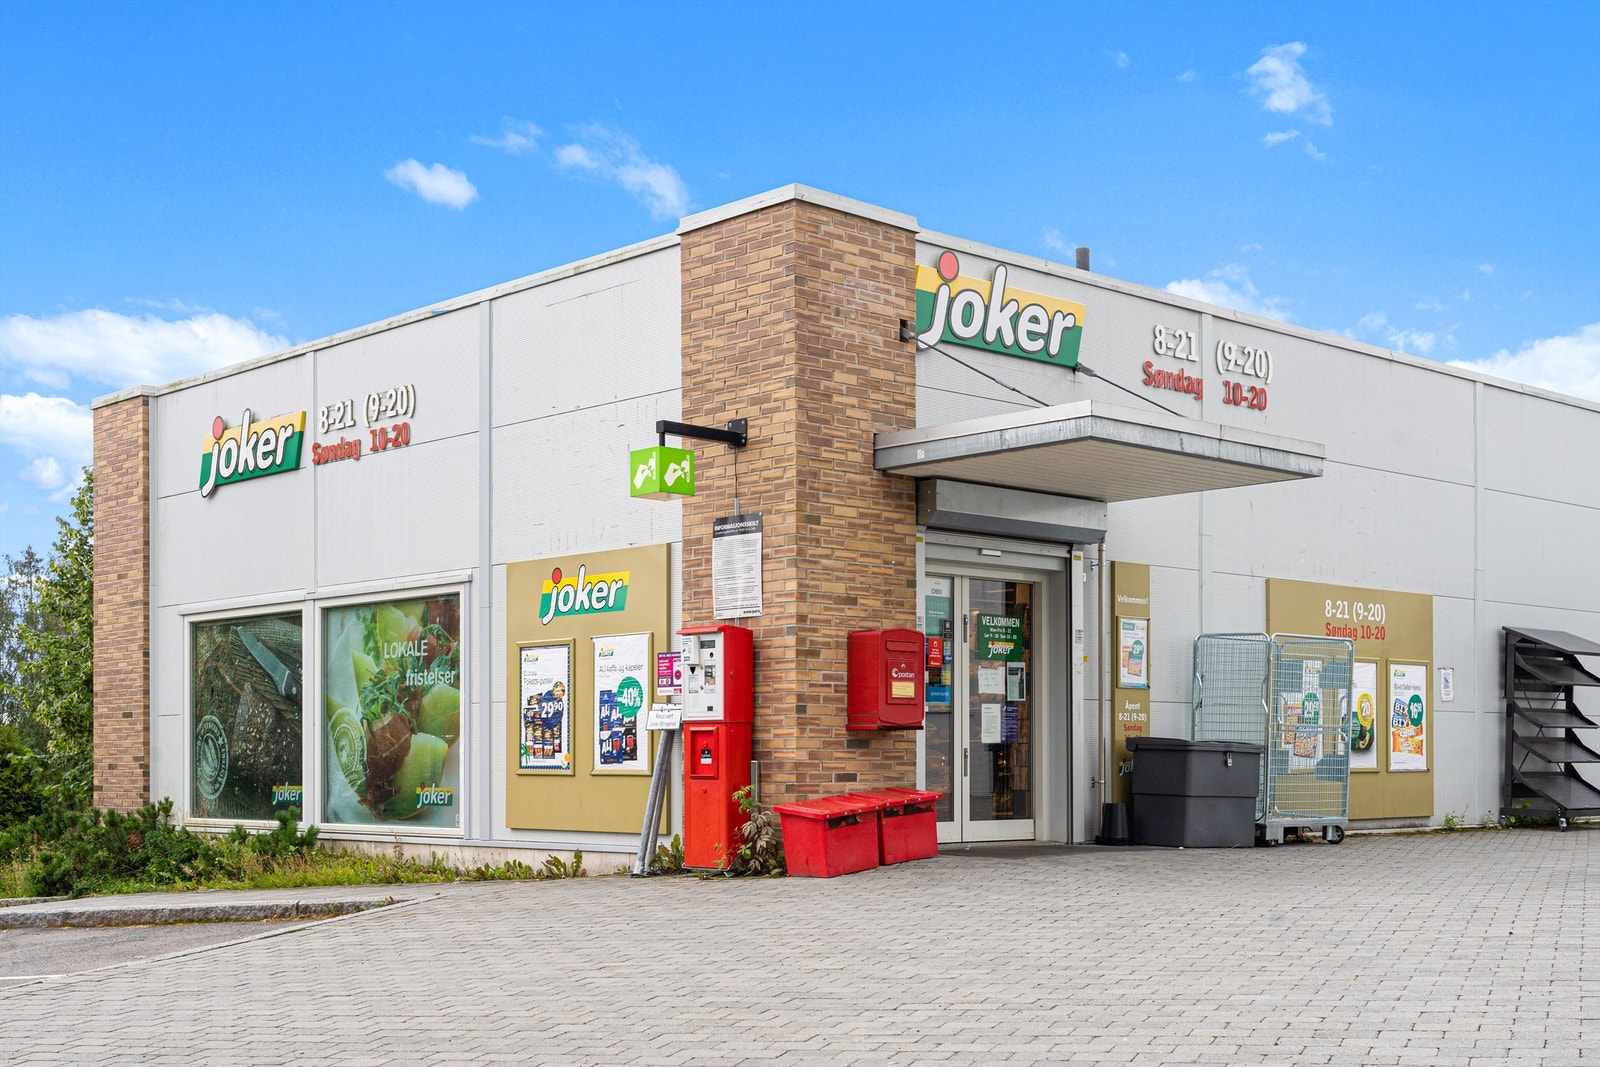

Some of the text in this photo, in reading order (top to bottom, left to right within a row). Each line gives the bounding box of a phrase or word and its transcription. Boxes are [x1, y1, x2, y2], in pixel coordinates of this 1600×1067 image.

[917, 250, 1077, 358] joker
[1153, 324, 1274, 385] 8-21 (9-20)
[1143, 360, 1268, 412] Søndag 10-20
[319, 384, 416, 434] 8-21 (9-20)
[201, 408, 294, 498] joker
[312, 422, 410, 467] Søndag 10-20
[542, 564, 624, 626] joker
[1117, 594, 1149, 606] Velkommen!
[981, 616, 1020, 628] VELKOMMEN
[1325, 600, 1386, 624] 8-21 (9-20)
[1325, 622, 1386, 641] Søndag 10-20
[384, 640, 428, 659] LOKALE
[988, 641, 1013, 659] joker
[406, 668, 456, 687] fristelser
[617, 687, 642, 707] -40%
[1125, 700, 1141, 711] Åpent
[1118, 712, 1147, 722] 8-21 (9-20)
[1360, 702, 1371, 717] 20
[1123, 723, 1143, 733] Søndag
[273, 781, 302, 806] joker
[417, 783, 451, 808] joker
